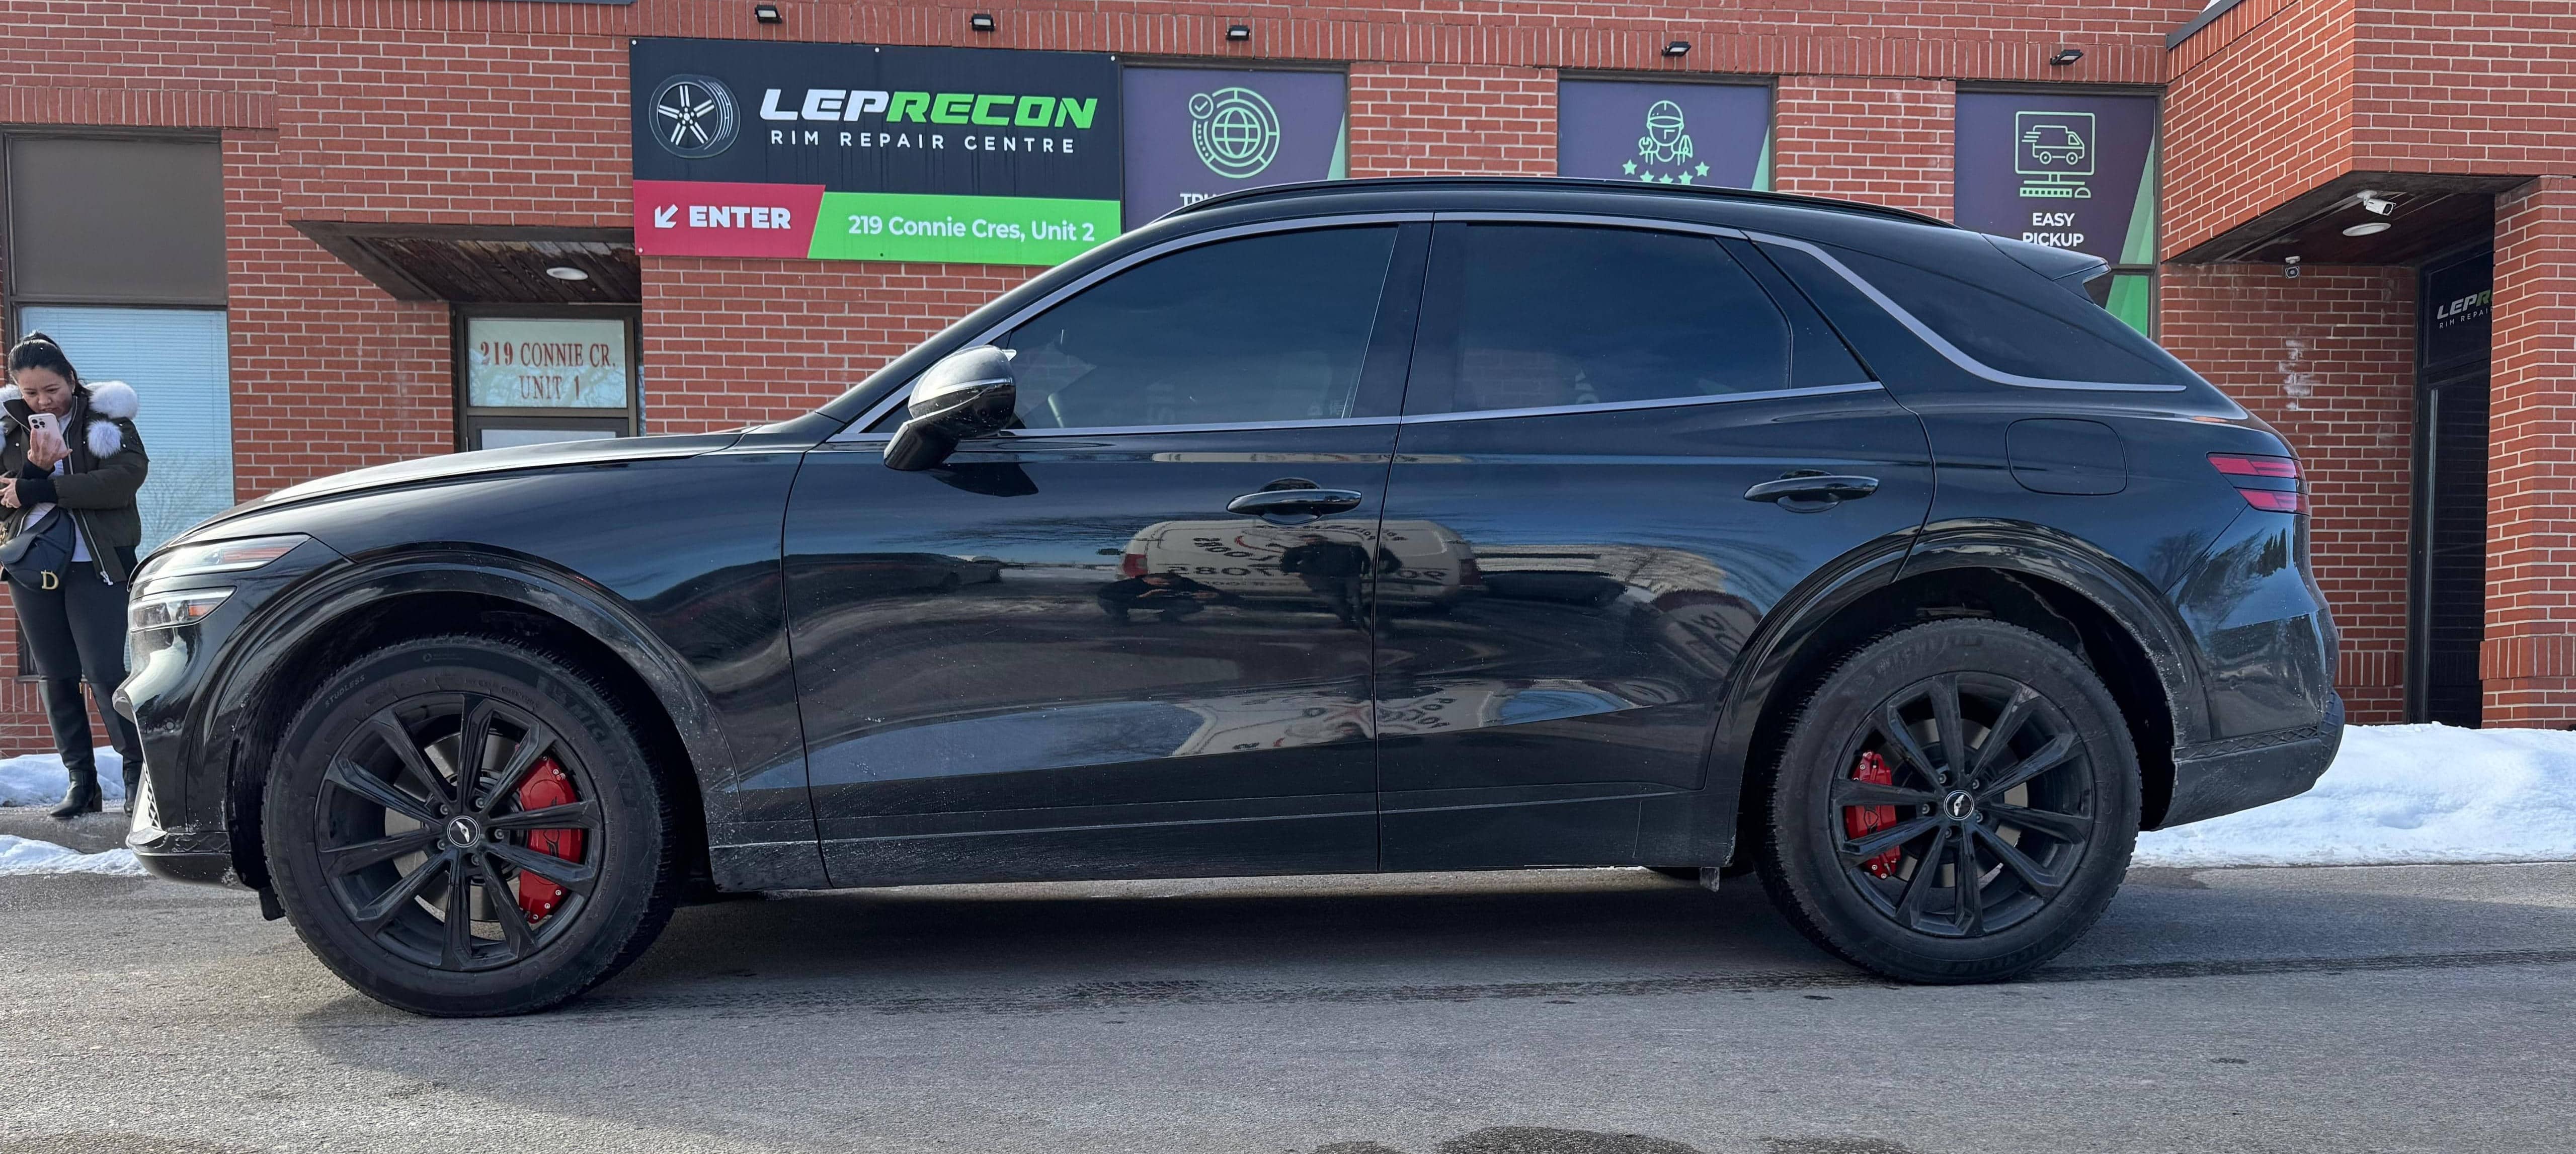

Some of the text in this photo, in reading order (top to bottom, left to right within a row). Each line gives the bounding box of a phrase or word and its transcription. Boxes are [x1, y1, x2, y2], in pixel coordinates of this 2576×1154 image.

[760, 89, 1098, 129] LEPRECON
[771, 129, 1074, 153] RIM REPAIR CENTRE
[689, 206, 791, 229] ENTER
[848, 215, 1095, 242] 219 Connie Cres, Unit 2
[2033, 212, 2075, 226] EASY
[2023, 232, 2084, 246] PICKUP
[2437, 289, 2491, 320] LEPR
[2439, 318, 2455, 329] RIM
[480, 342, 615, 367] 219 CONNIE CR.
[519, 375, 580, 399] UNIT 1
[325, 675, 365, 708] STUDLESS
